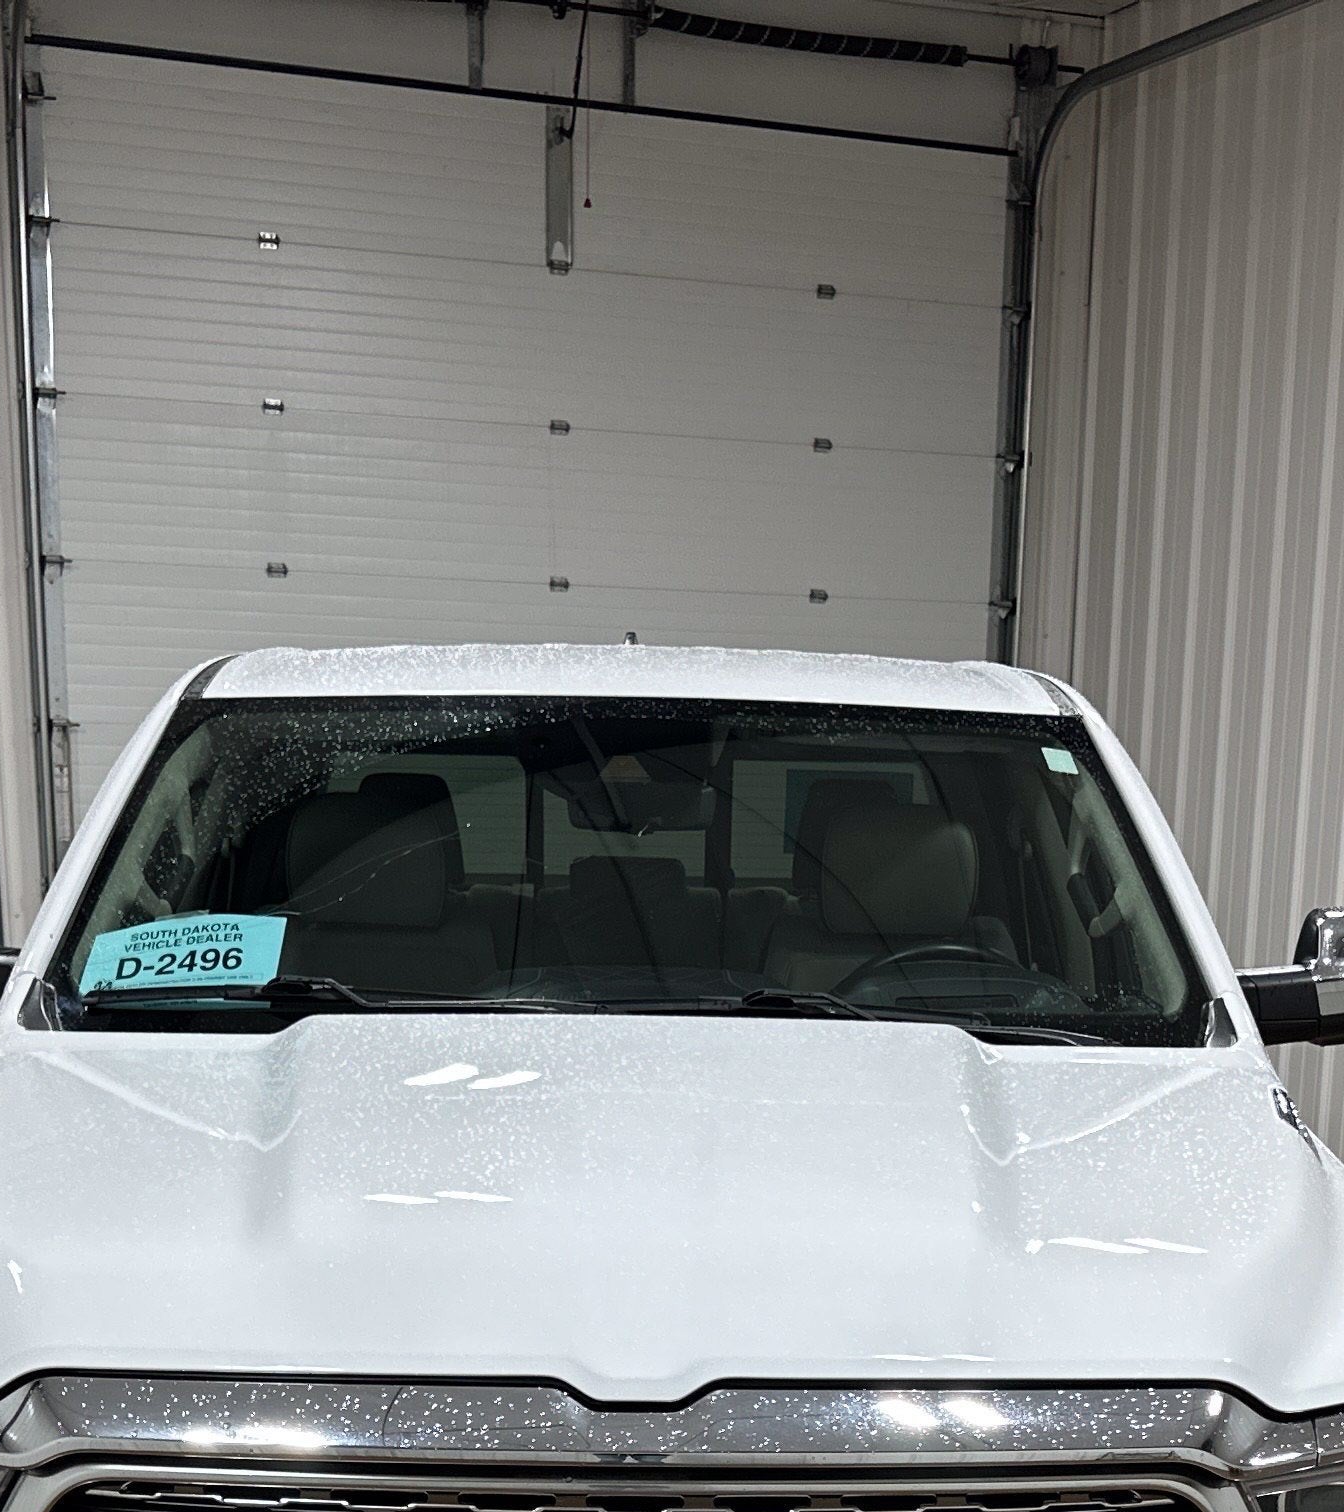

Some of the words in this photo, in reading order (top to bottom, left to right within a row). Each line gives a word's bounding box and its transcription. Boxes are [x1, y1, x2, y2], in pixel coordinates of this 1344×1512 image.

[130, 929, 178, 942] SOUTH
[182, 922, 240, 936] DAKOTA
[124, 938, 182, 953] VEHICLE
[186, 933, 244, 946] DEALER
[115, 947, 244, 981] D-2496
